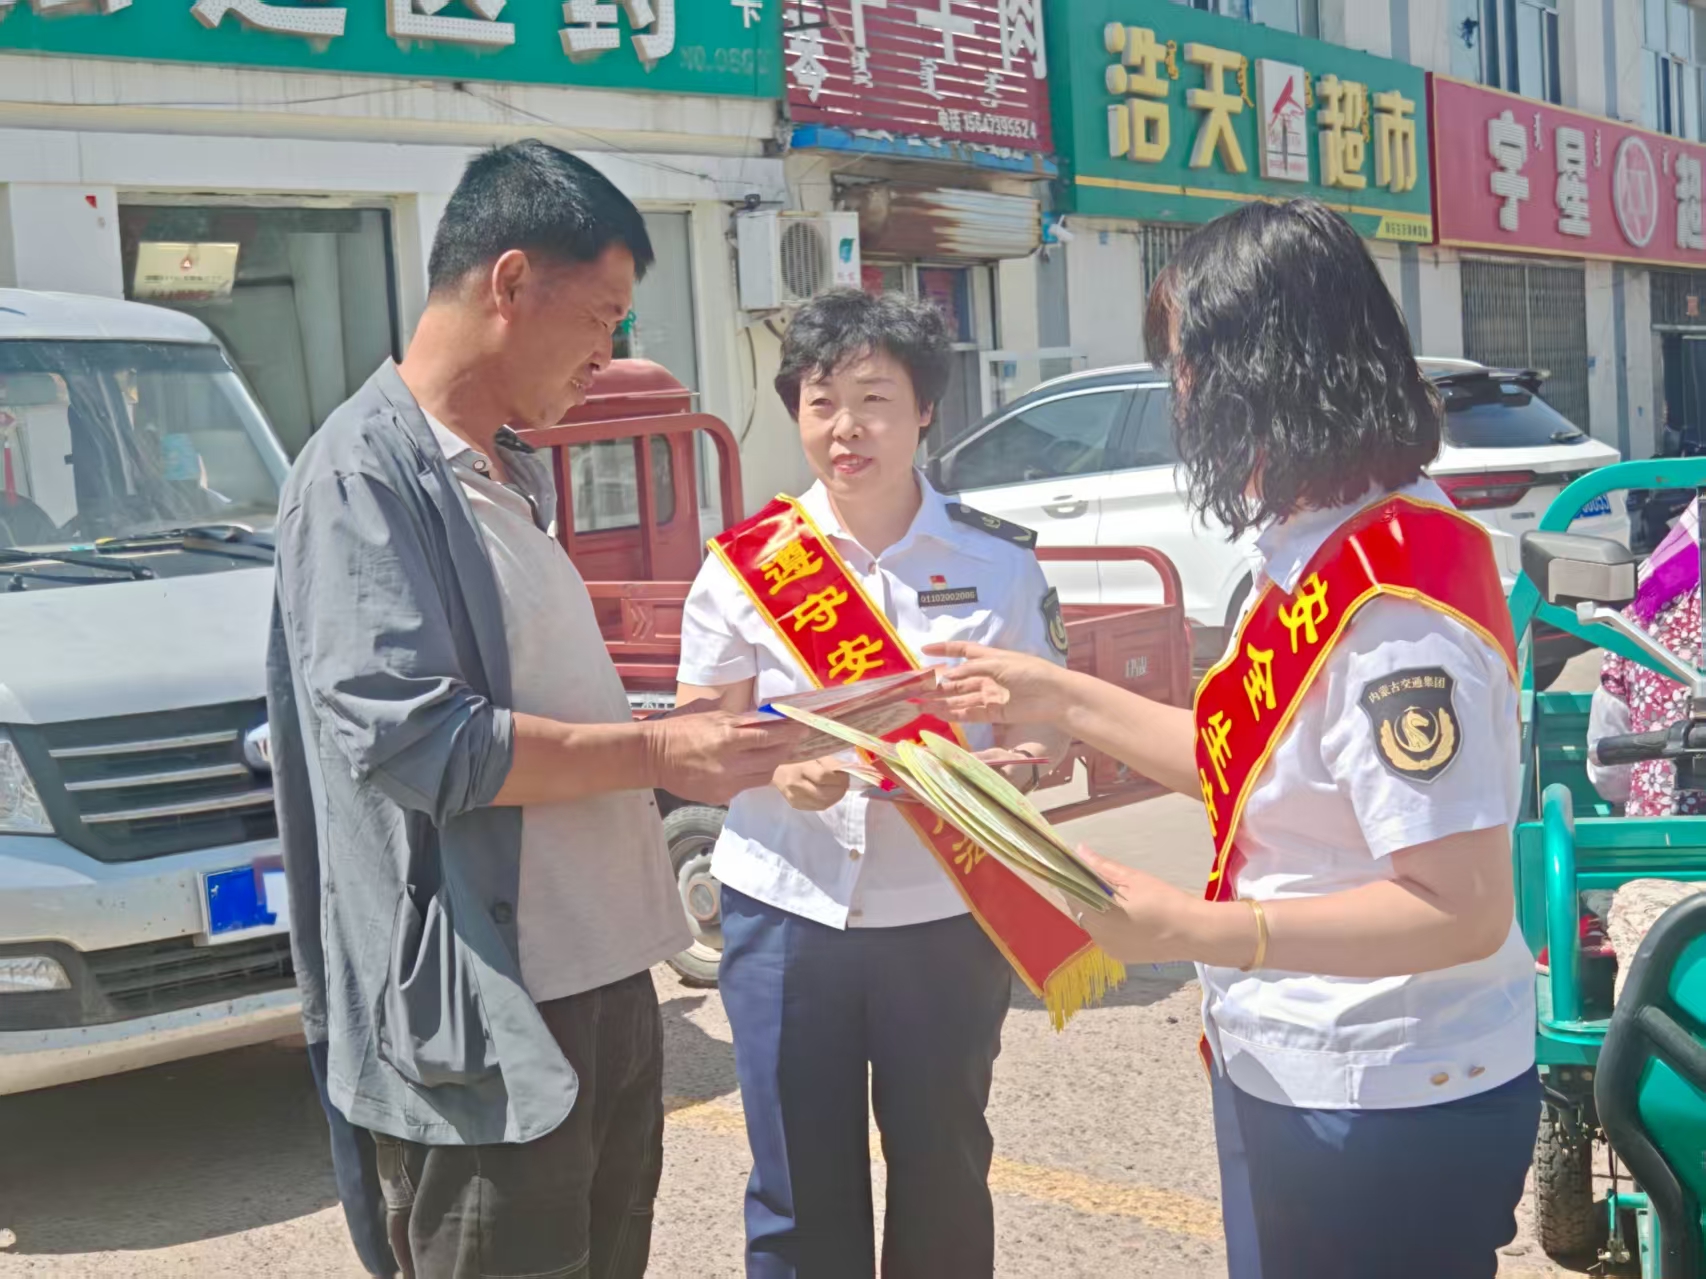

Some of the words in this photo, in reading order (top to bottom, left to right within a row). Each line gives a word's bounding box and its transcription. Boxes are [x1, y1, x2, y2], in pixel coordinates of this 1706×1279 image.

[1368, 675, 1446, 704] 内蒙古交通集团
